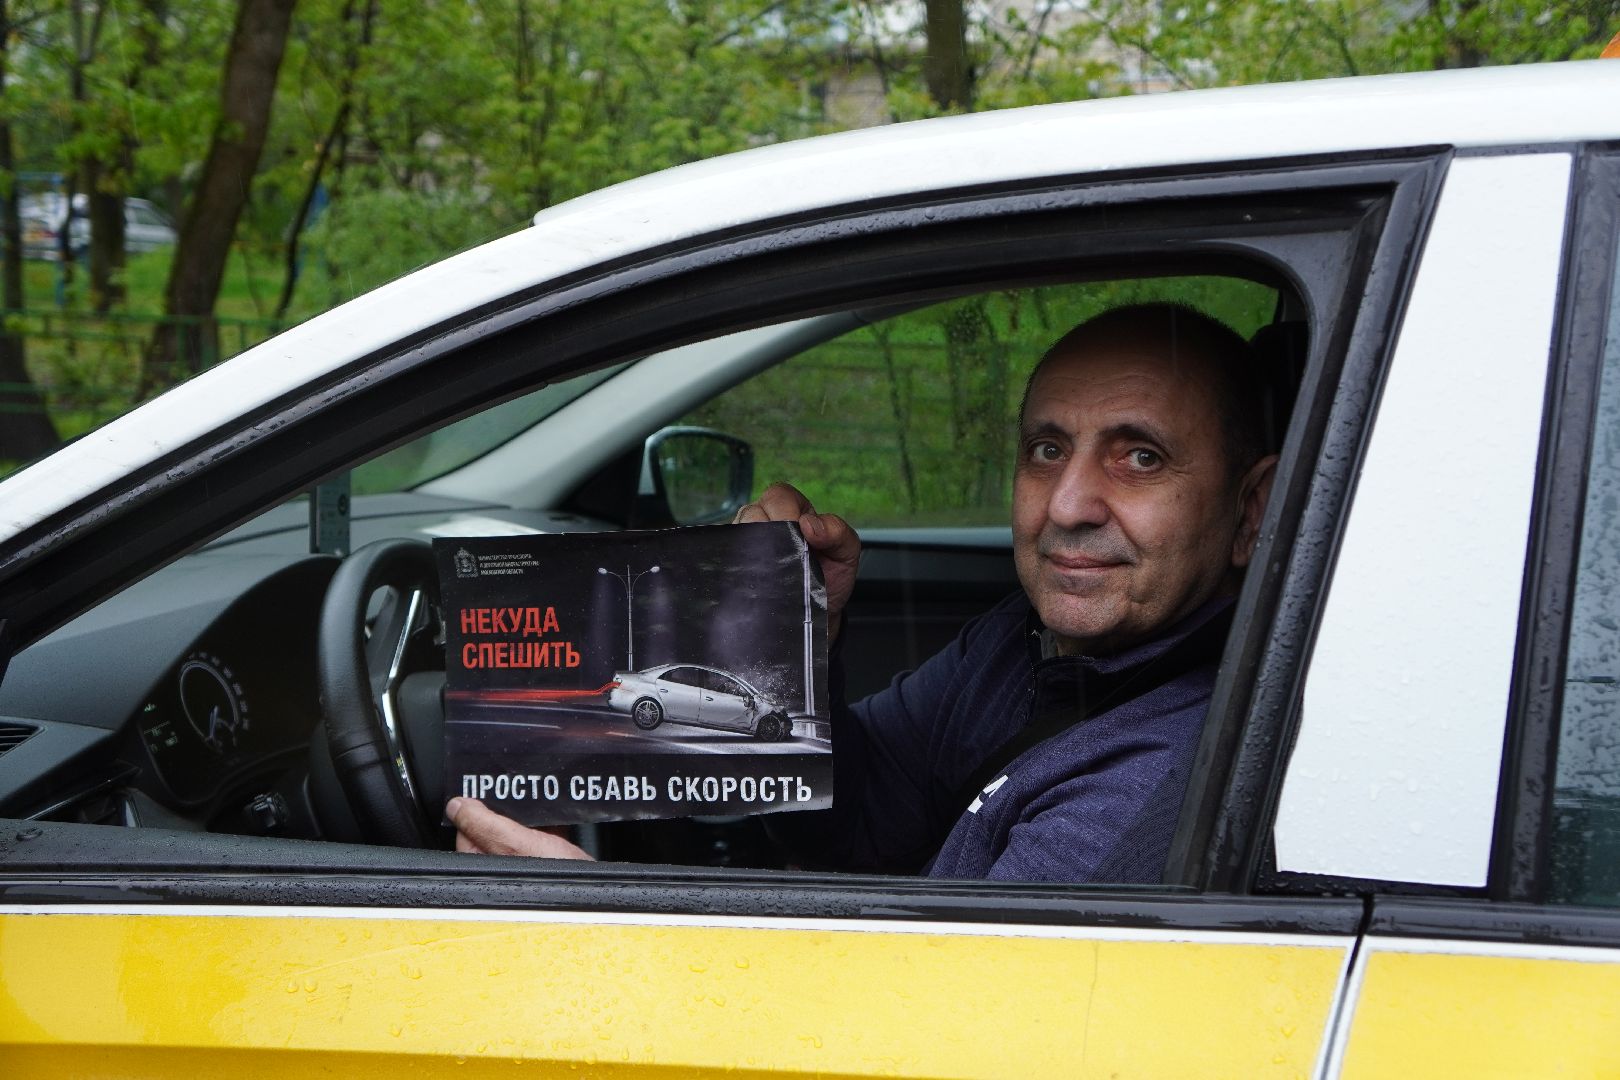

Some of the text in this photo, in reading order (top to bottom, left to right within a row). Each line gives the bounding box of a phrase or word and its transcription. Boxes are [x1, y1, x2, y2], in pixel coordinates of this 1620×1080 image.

[461, 607, 560, 637] НЕКУДА
[462, 642, 581, 668] СПЕШИТЬ
[462, 774, 812, 802] ПРОСТО СБАВЬ СКОРОСТЬ
